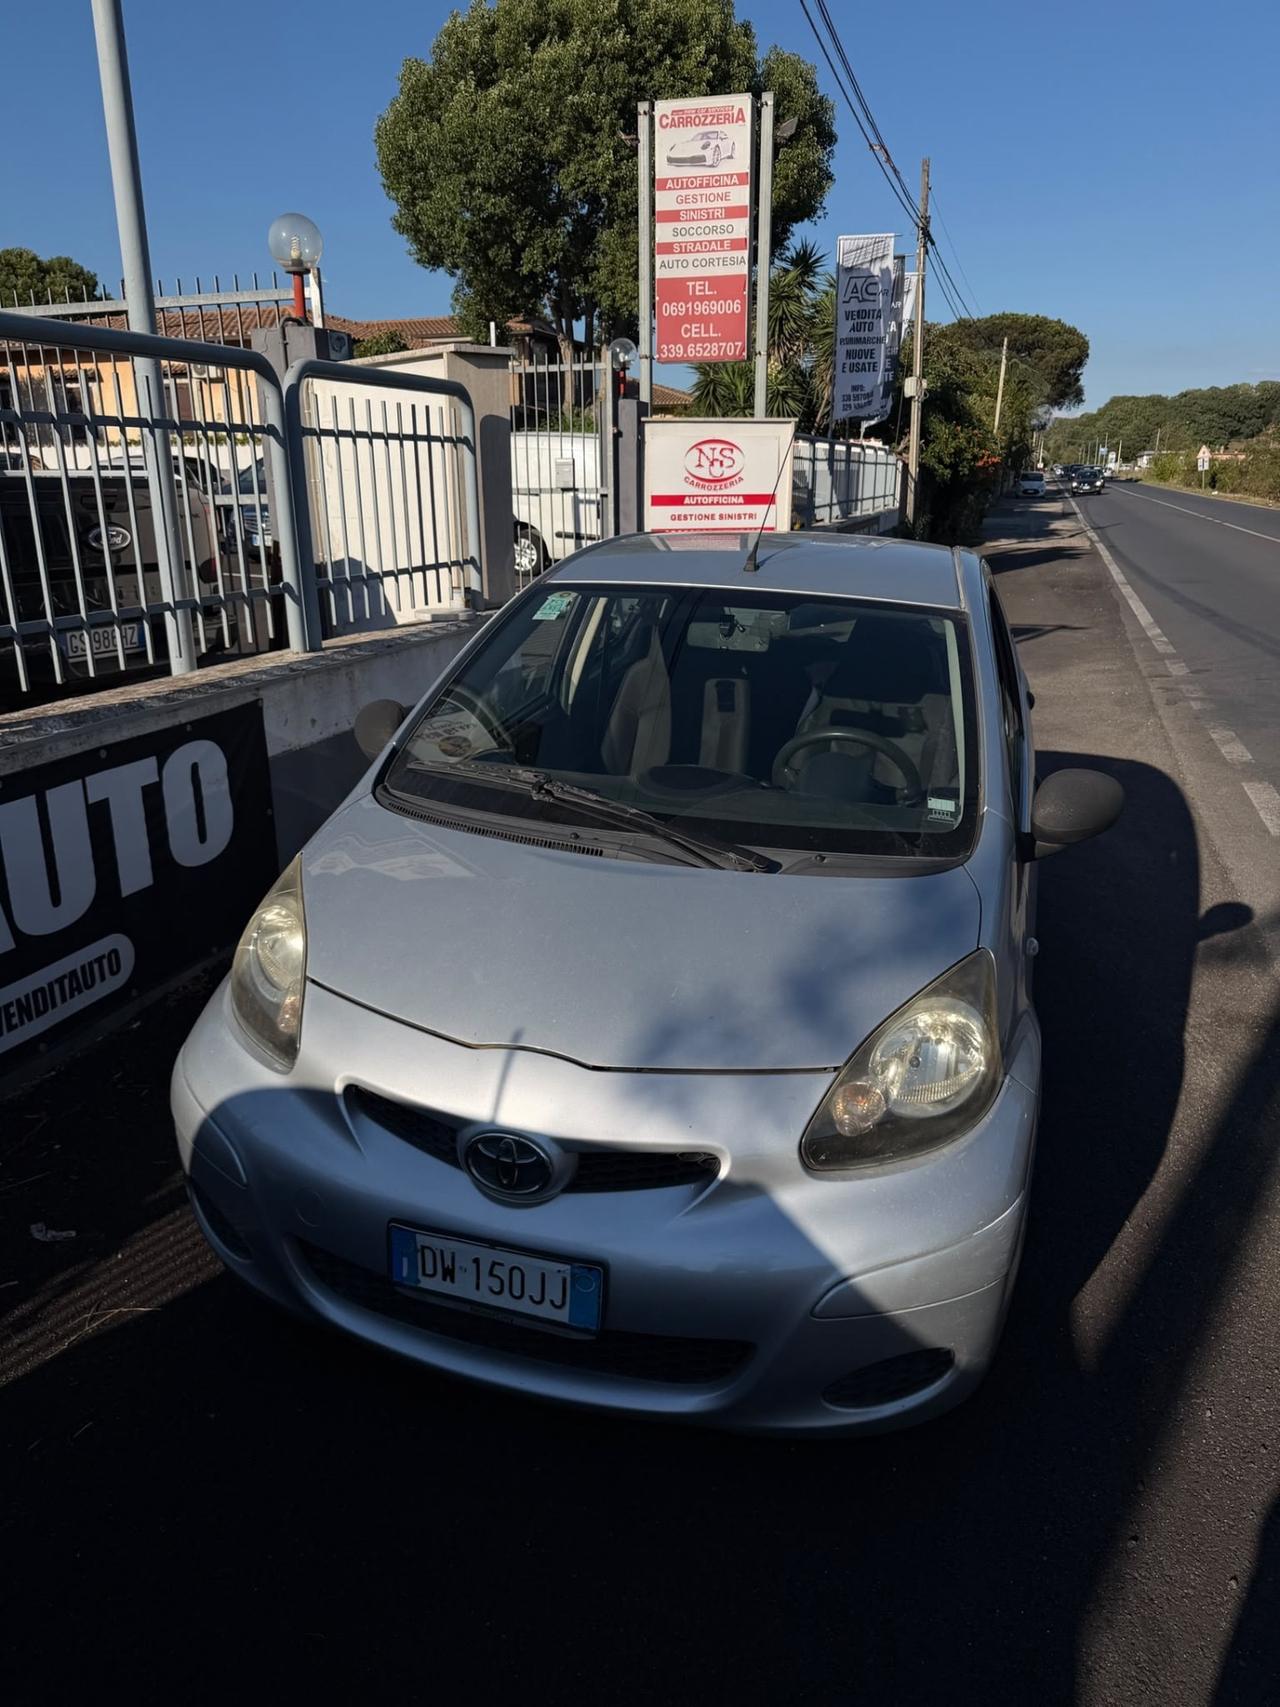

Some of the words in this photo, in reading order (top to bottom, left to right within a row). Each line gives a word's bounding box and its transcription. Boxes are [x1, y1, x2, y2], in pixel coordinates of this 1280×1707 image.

[659, 107, 746, 129] CARROZZERIA
[666, 174, 740, 189] AUTOFFICINA
[676, 191, 731, 205] GESTIONE
[680, 209, 725, 221] SINISTRI
[672, 224, 734, 237] SOCCORSO
[673, 240, 731, 253] STRADALE
[659, 258, 689, 270] AUTO
[692, 256, 746, 268] CORTESIA
[687, 281, 717, 295] TEL.
[662, 299, 741, 316] 0691969006
[681, 323, 721, 338] CELL.
[849, 321, 874, 332] AUTO
[842, 362, 847, 373] E
[849, 361, 878, 373] USATE
[684, 476, 744, 491] CARROZZERIA
[684, 495, 744, 505] AUTOFFICINA
[670, 513, 716, 521] GESTIONE
[718, 513, 757, 521] SINISTRI
[0, 739, 234, 953] UTO
[420, 1245, 456, 1284] DW
[472, 1257, 568, 1309] 150JJ
